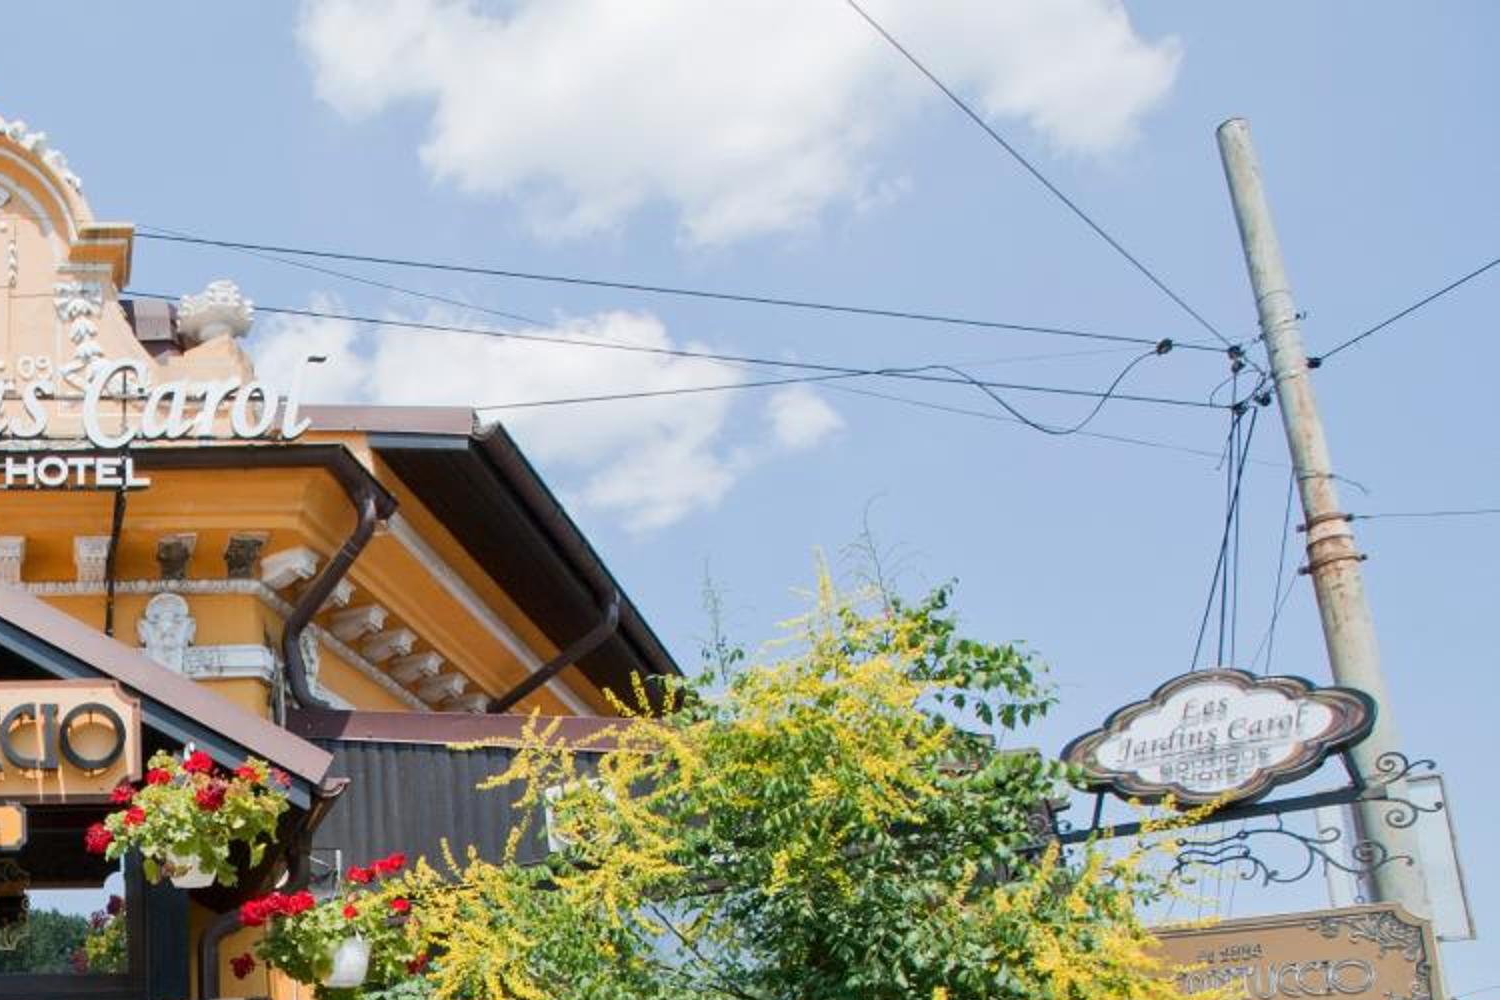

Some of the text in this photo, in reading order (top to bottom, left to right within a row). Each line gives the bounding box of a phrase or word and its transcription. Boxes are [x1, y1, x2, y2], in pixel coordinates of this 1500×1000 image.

[83, 353, 334, 449] Carol
[4, 455, 151, 487] HOTEL
[1182, 698, 1229, 722] Les
[1122, 701, 1309, 764] Jardins Carol
[1159, 747, 1270, 777] BOUTIQUE
